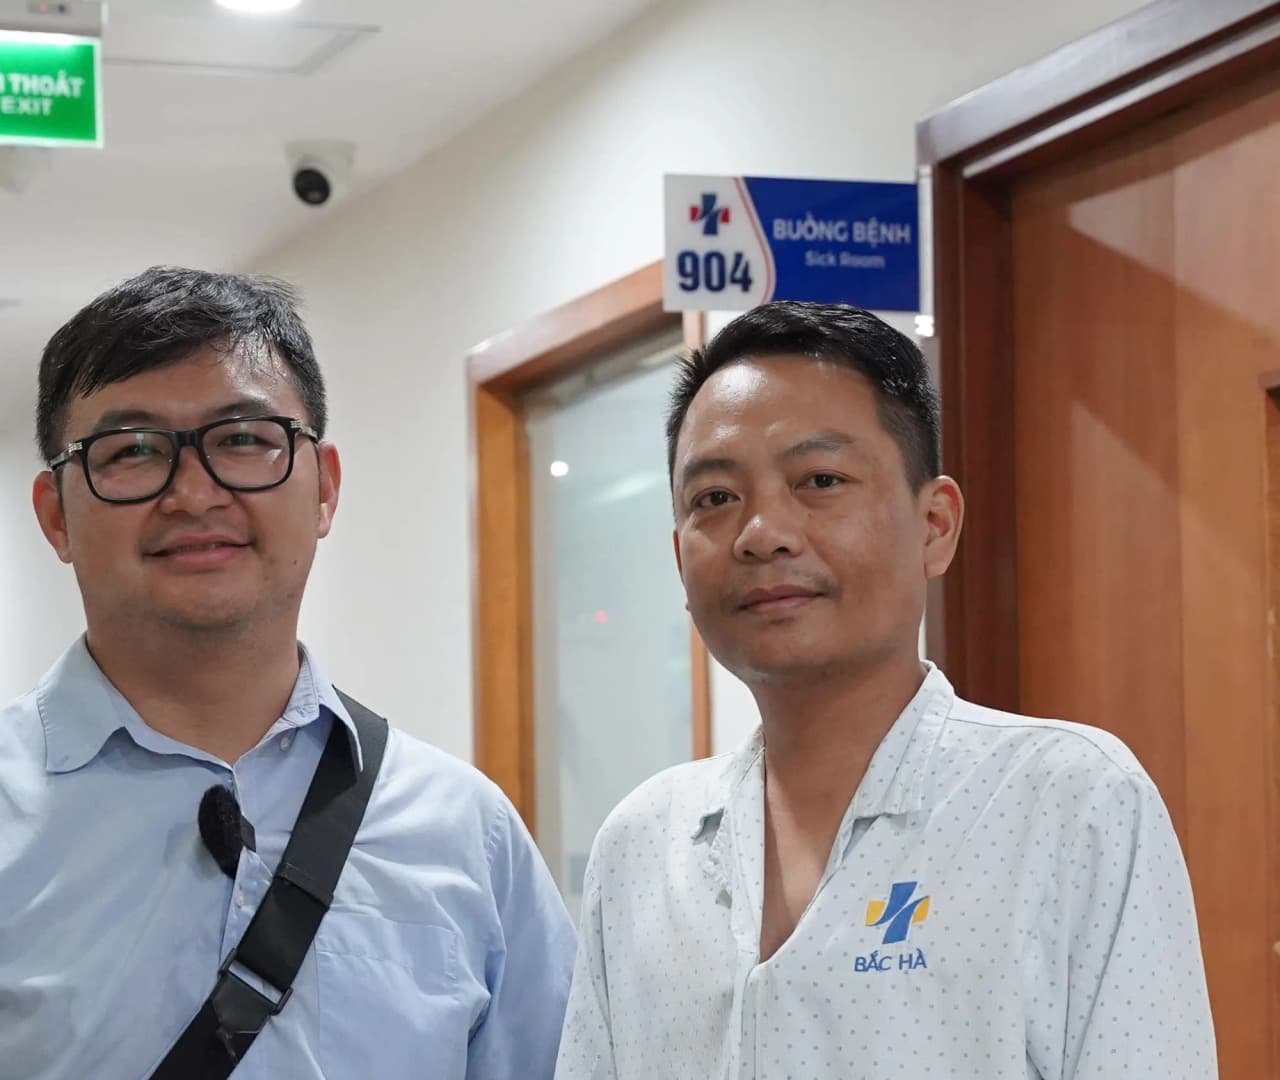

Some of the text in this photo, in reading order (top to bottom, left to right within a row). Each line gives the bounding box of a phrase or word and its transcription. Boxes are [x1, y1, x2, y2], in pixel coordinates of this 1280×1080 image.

[8, 68, 85, 99] THOÁT
[0, 96, 52, 116] EXIT
[773, 212, 911, 248] BUỒNG BỆNH
[678, 250, 752, 293] 904
[805, 251, 885, 268] Sick Room
[854, 948, 927, 972] BẮC HÀ
